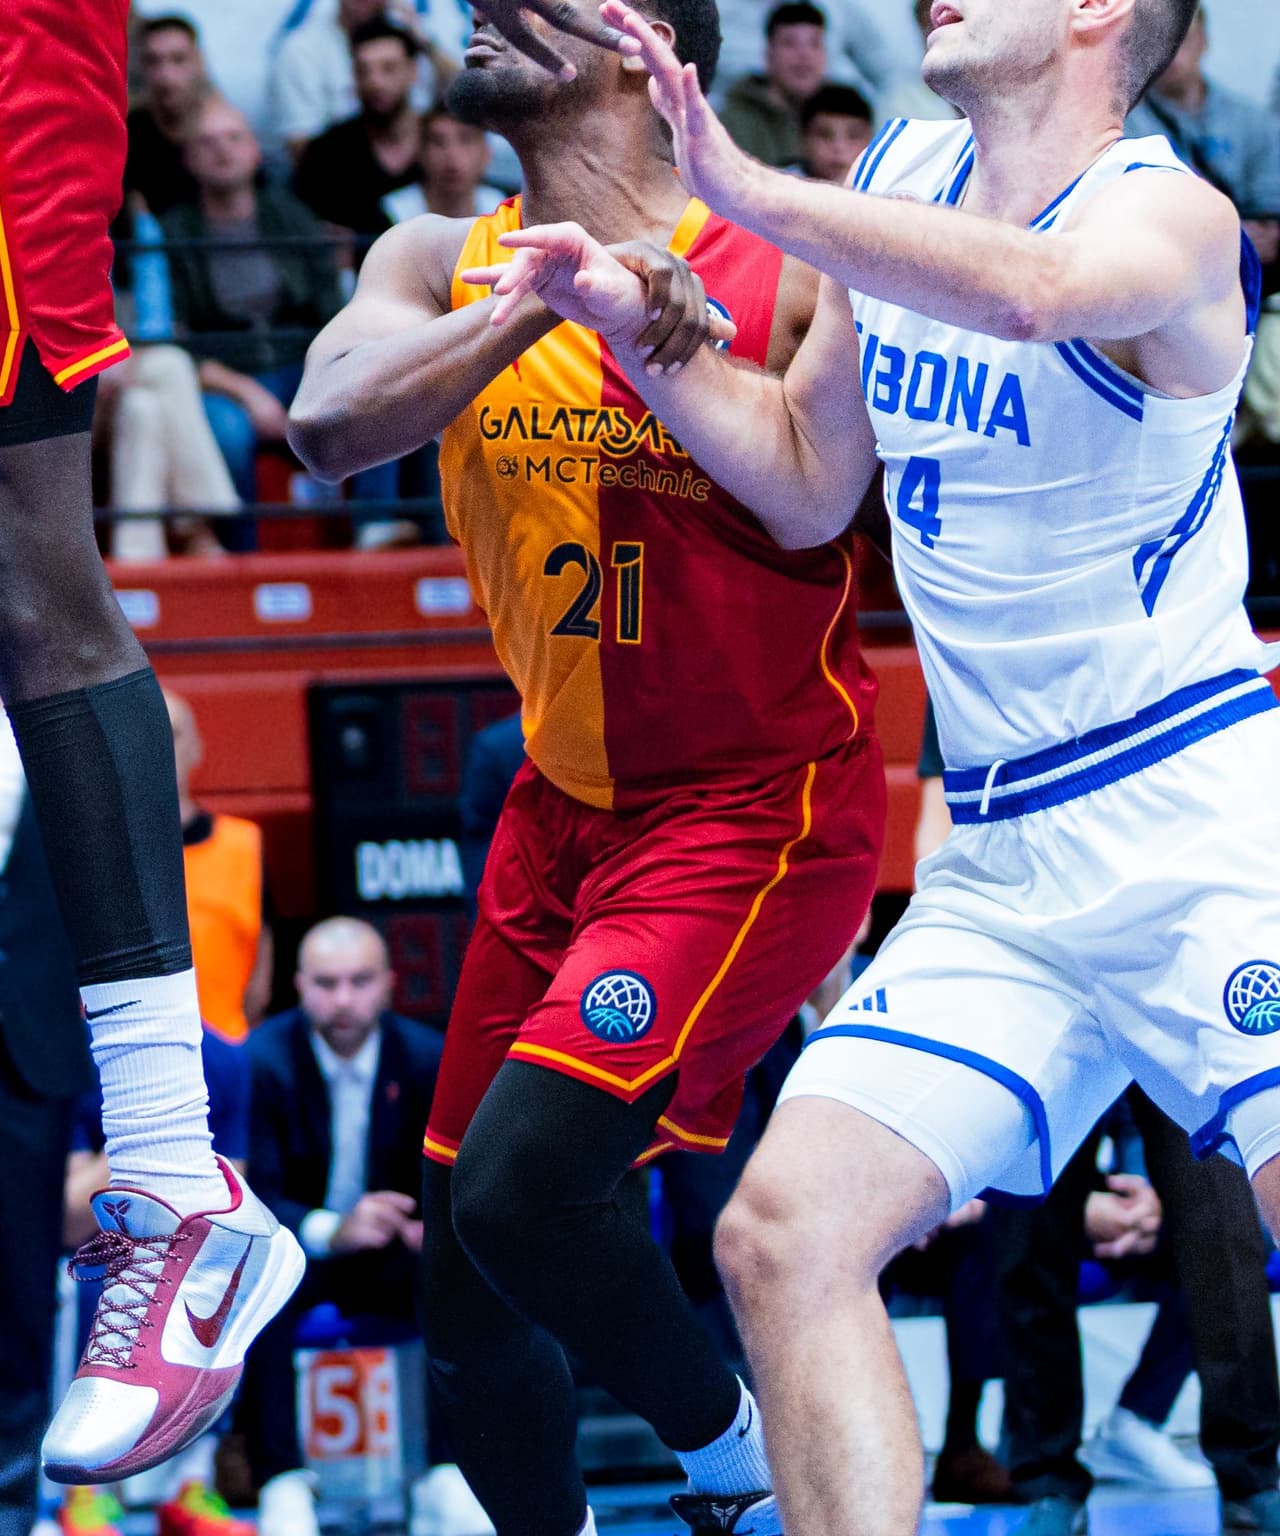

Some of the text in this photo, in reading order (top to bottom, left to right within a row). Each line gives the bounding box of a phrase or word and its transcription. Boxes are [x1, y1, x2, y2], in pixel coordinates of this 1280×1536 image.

[479, 404, 690, 459] GALATASAR
[854, 320, 1032, 448] IBONA
[525, 453, 711, 502] MCTechnic
[896, 455, 943, 550] 4
[543, 540, 645, 644] 21
